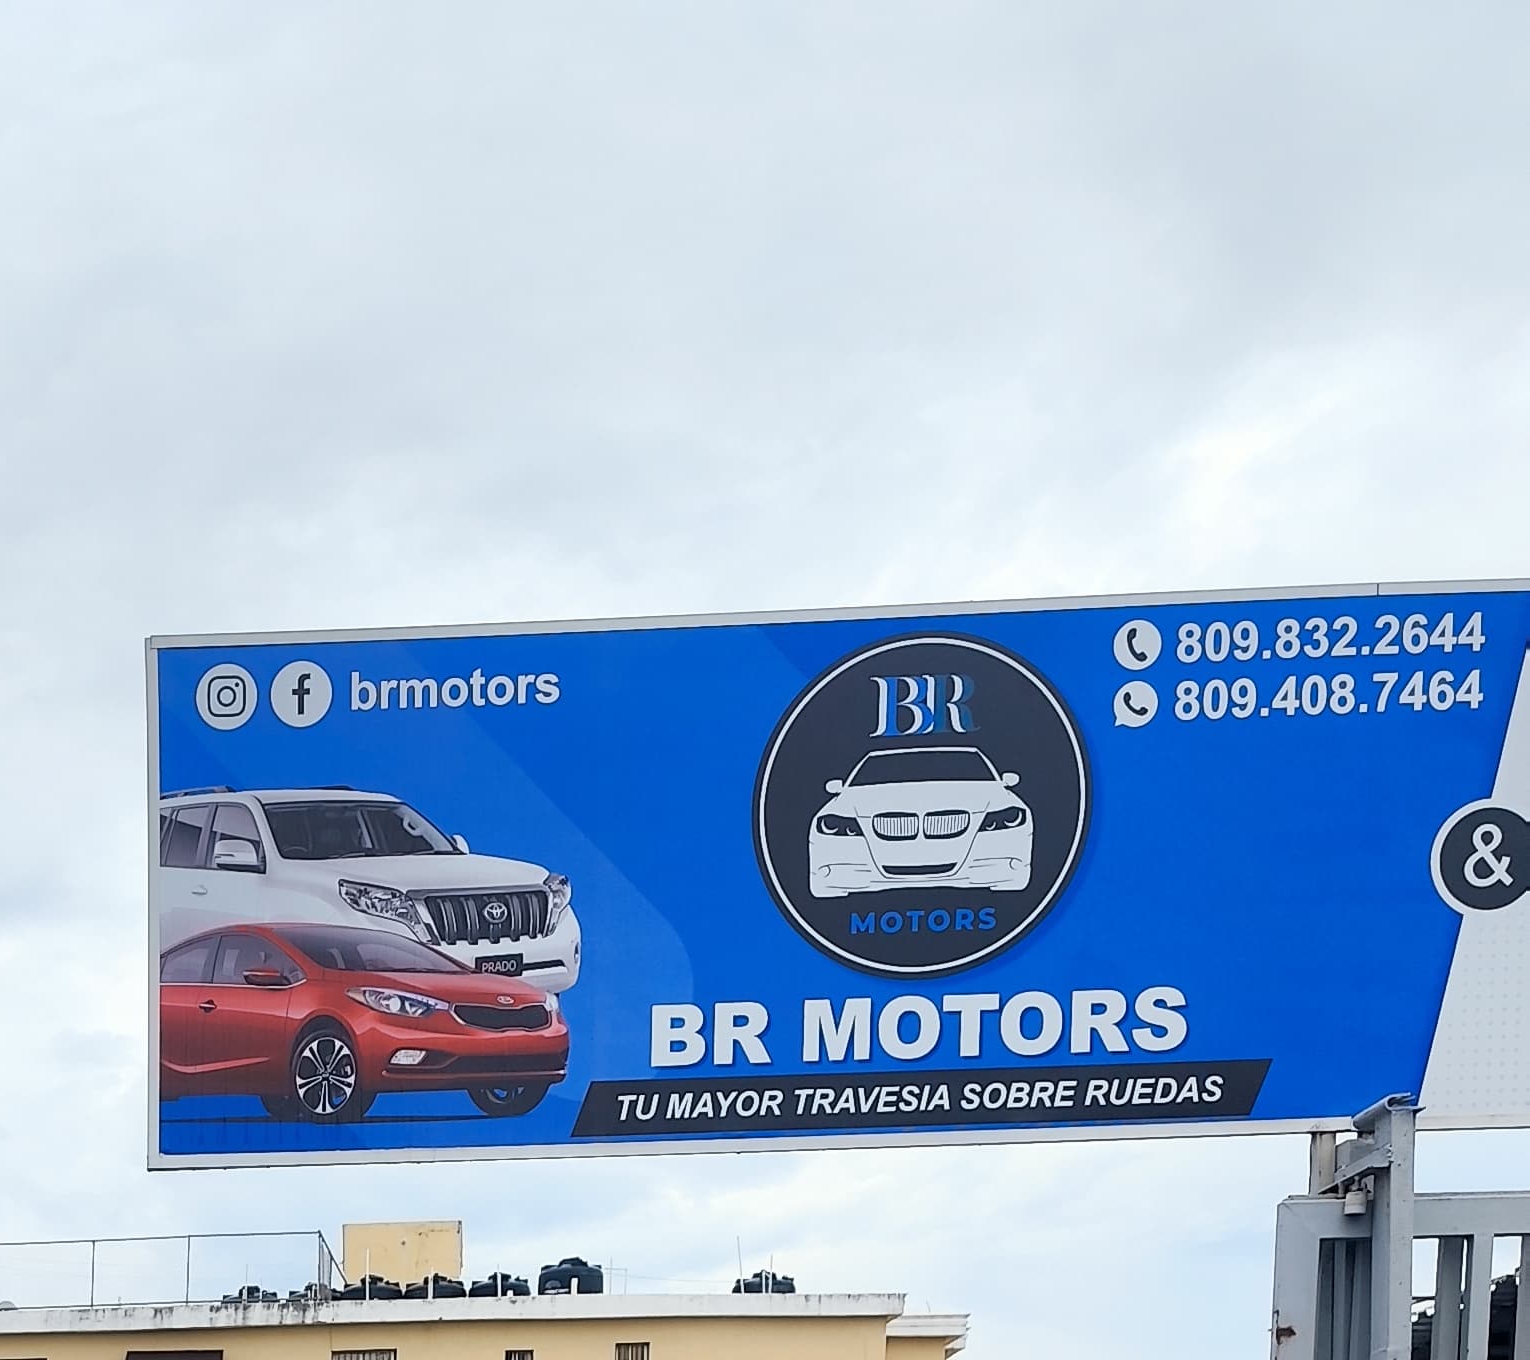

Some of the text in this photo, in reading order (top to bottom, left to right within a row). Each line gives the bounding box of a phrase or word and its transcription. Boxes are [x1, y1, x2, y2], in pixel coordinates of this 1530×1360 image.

[1176, 611, 1486, 663] 809.832.2644
[351, 668, 560, 711] brmotors
[869, 673, 981, 737] BR
[1174, 669, 1484, 721] 809.408.7464
[1464, 823, 1514, 887] &
[850, 907, 997, 935] MOTORS
[481, 959, 517, 973] PRADO
[650, 986, 1187, 1068] BR MOTORS
[617, 1075, 1224, 1121] TU MAYOR TRAVESIA SOBRE RUEDAS
